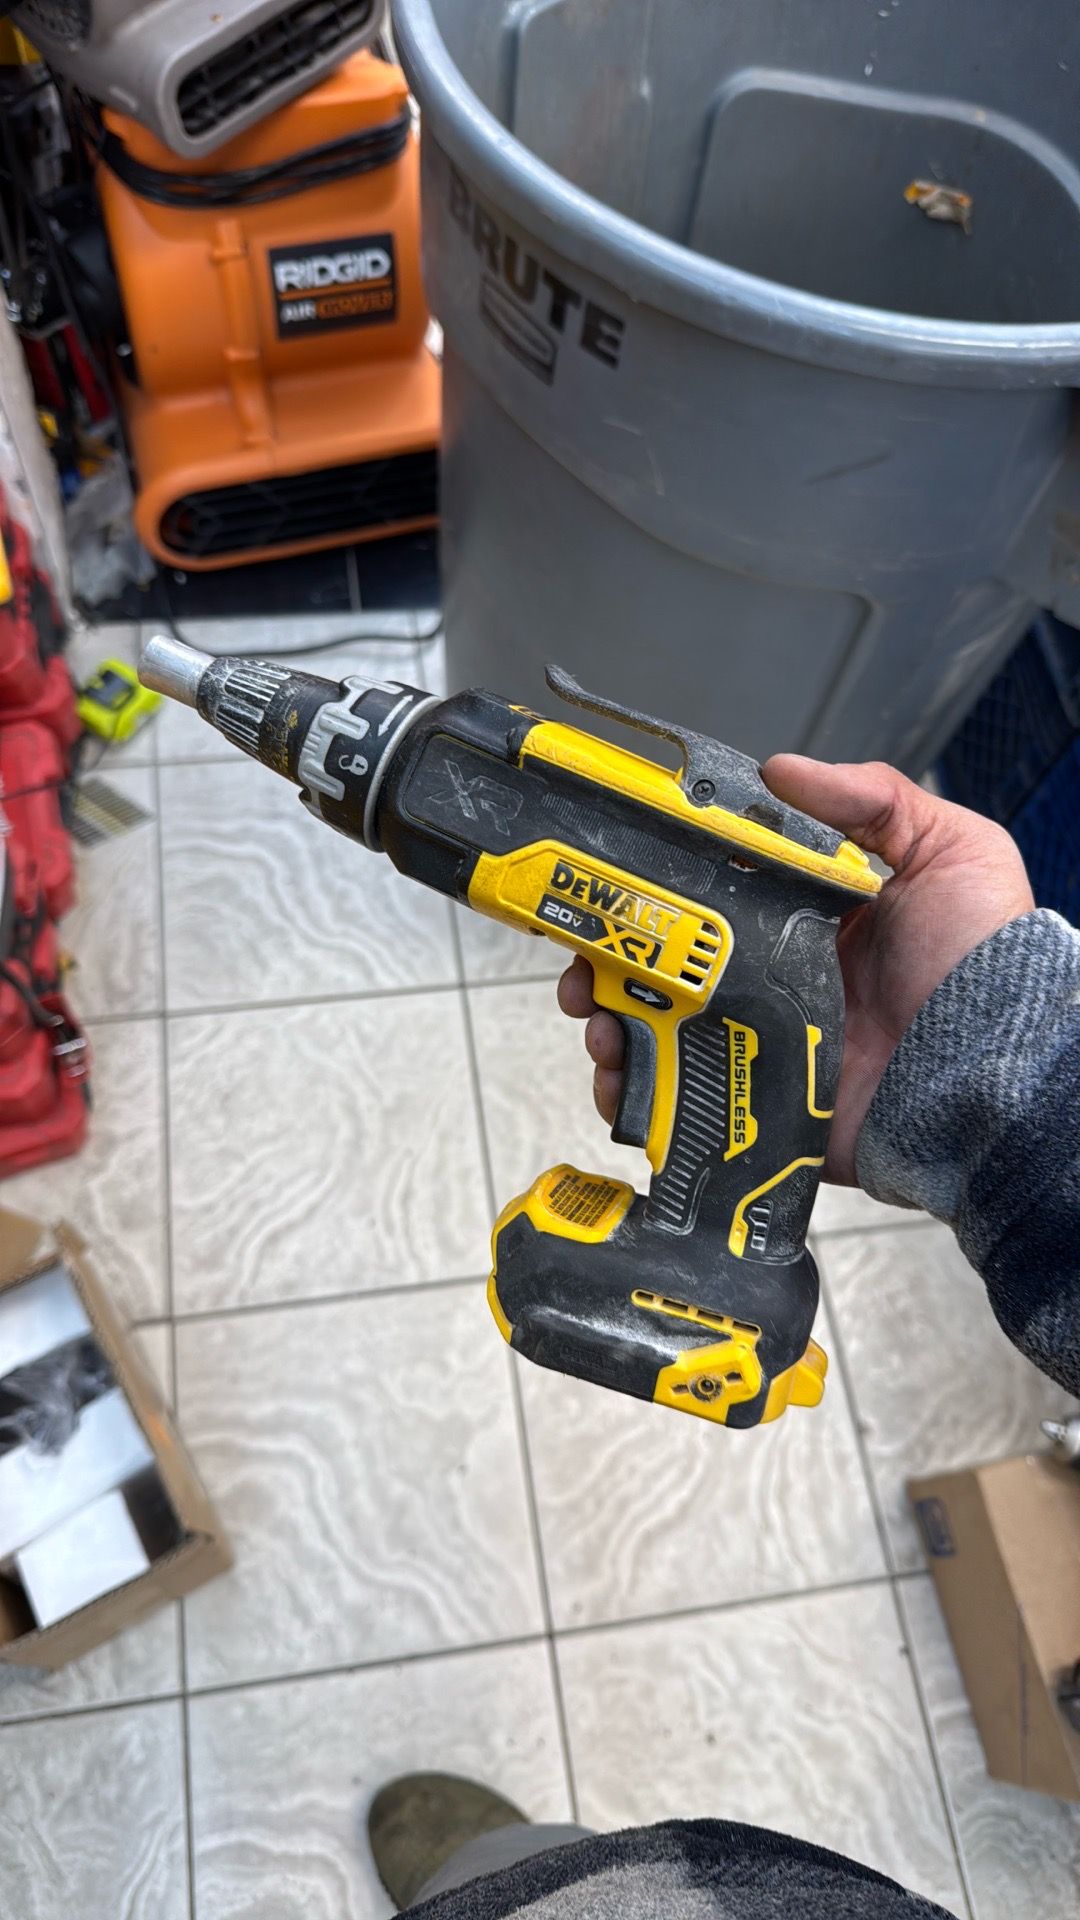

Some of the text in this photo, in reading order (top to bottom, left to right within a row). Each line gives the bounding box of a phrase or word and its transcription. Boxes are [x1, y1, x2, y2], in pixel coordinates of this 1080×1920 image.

[274, 248, 391, 293] RIDGID
[449, 163, 626, 370] BRUTE
[281, 300, 317, 322] AIR
[424, 758, 524, 837] XR
[591, 918, 656, 969] XR
[733, 1031, 746, 1145] BRUSHLESS
